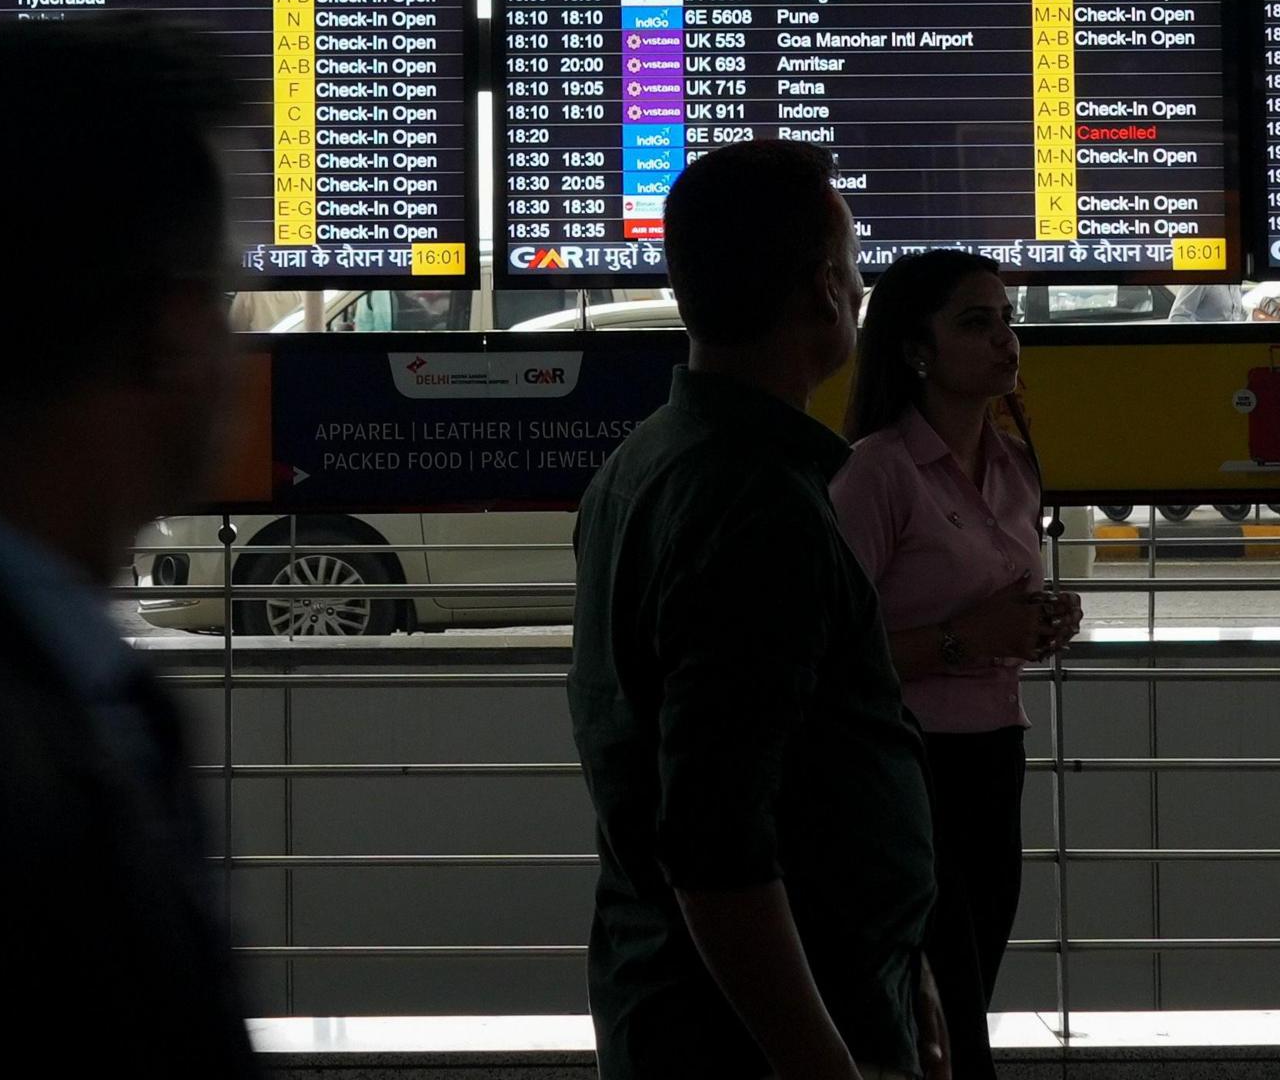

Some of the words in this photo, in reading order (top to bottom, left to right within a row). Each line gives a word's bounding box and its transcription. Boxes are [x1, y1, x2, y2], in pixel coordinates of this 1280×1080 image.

[1076, 123, 1159, 139] Cancelled
[269, 250, 307, 267] यात्रा
[335, 244, 382, 267] दौरान
[417, 249, 459, 268] 16:01
[416, 374, 450, 385] DELHI
[524, 368, 565, 385] GMR
[315, 423, 405, 440] APPAREL
[424, 422, 511, 439] LEATHER
[324, 452, 400, 470] PACKED
[408, 452, 462, 469] FOOD
[482, 451, 520, 469] P&C
[537, 450, 609, 469] JEWELL
